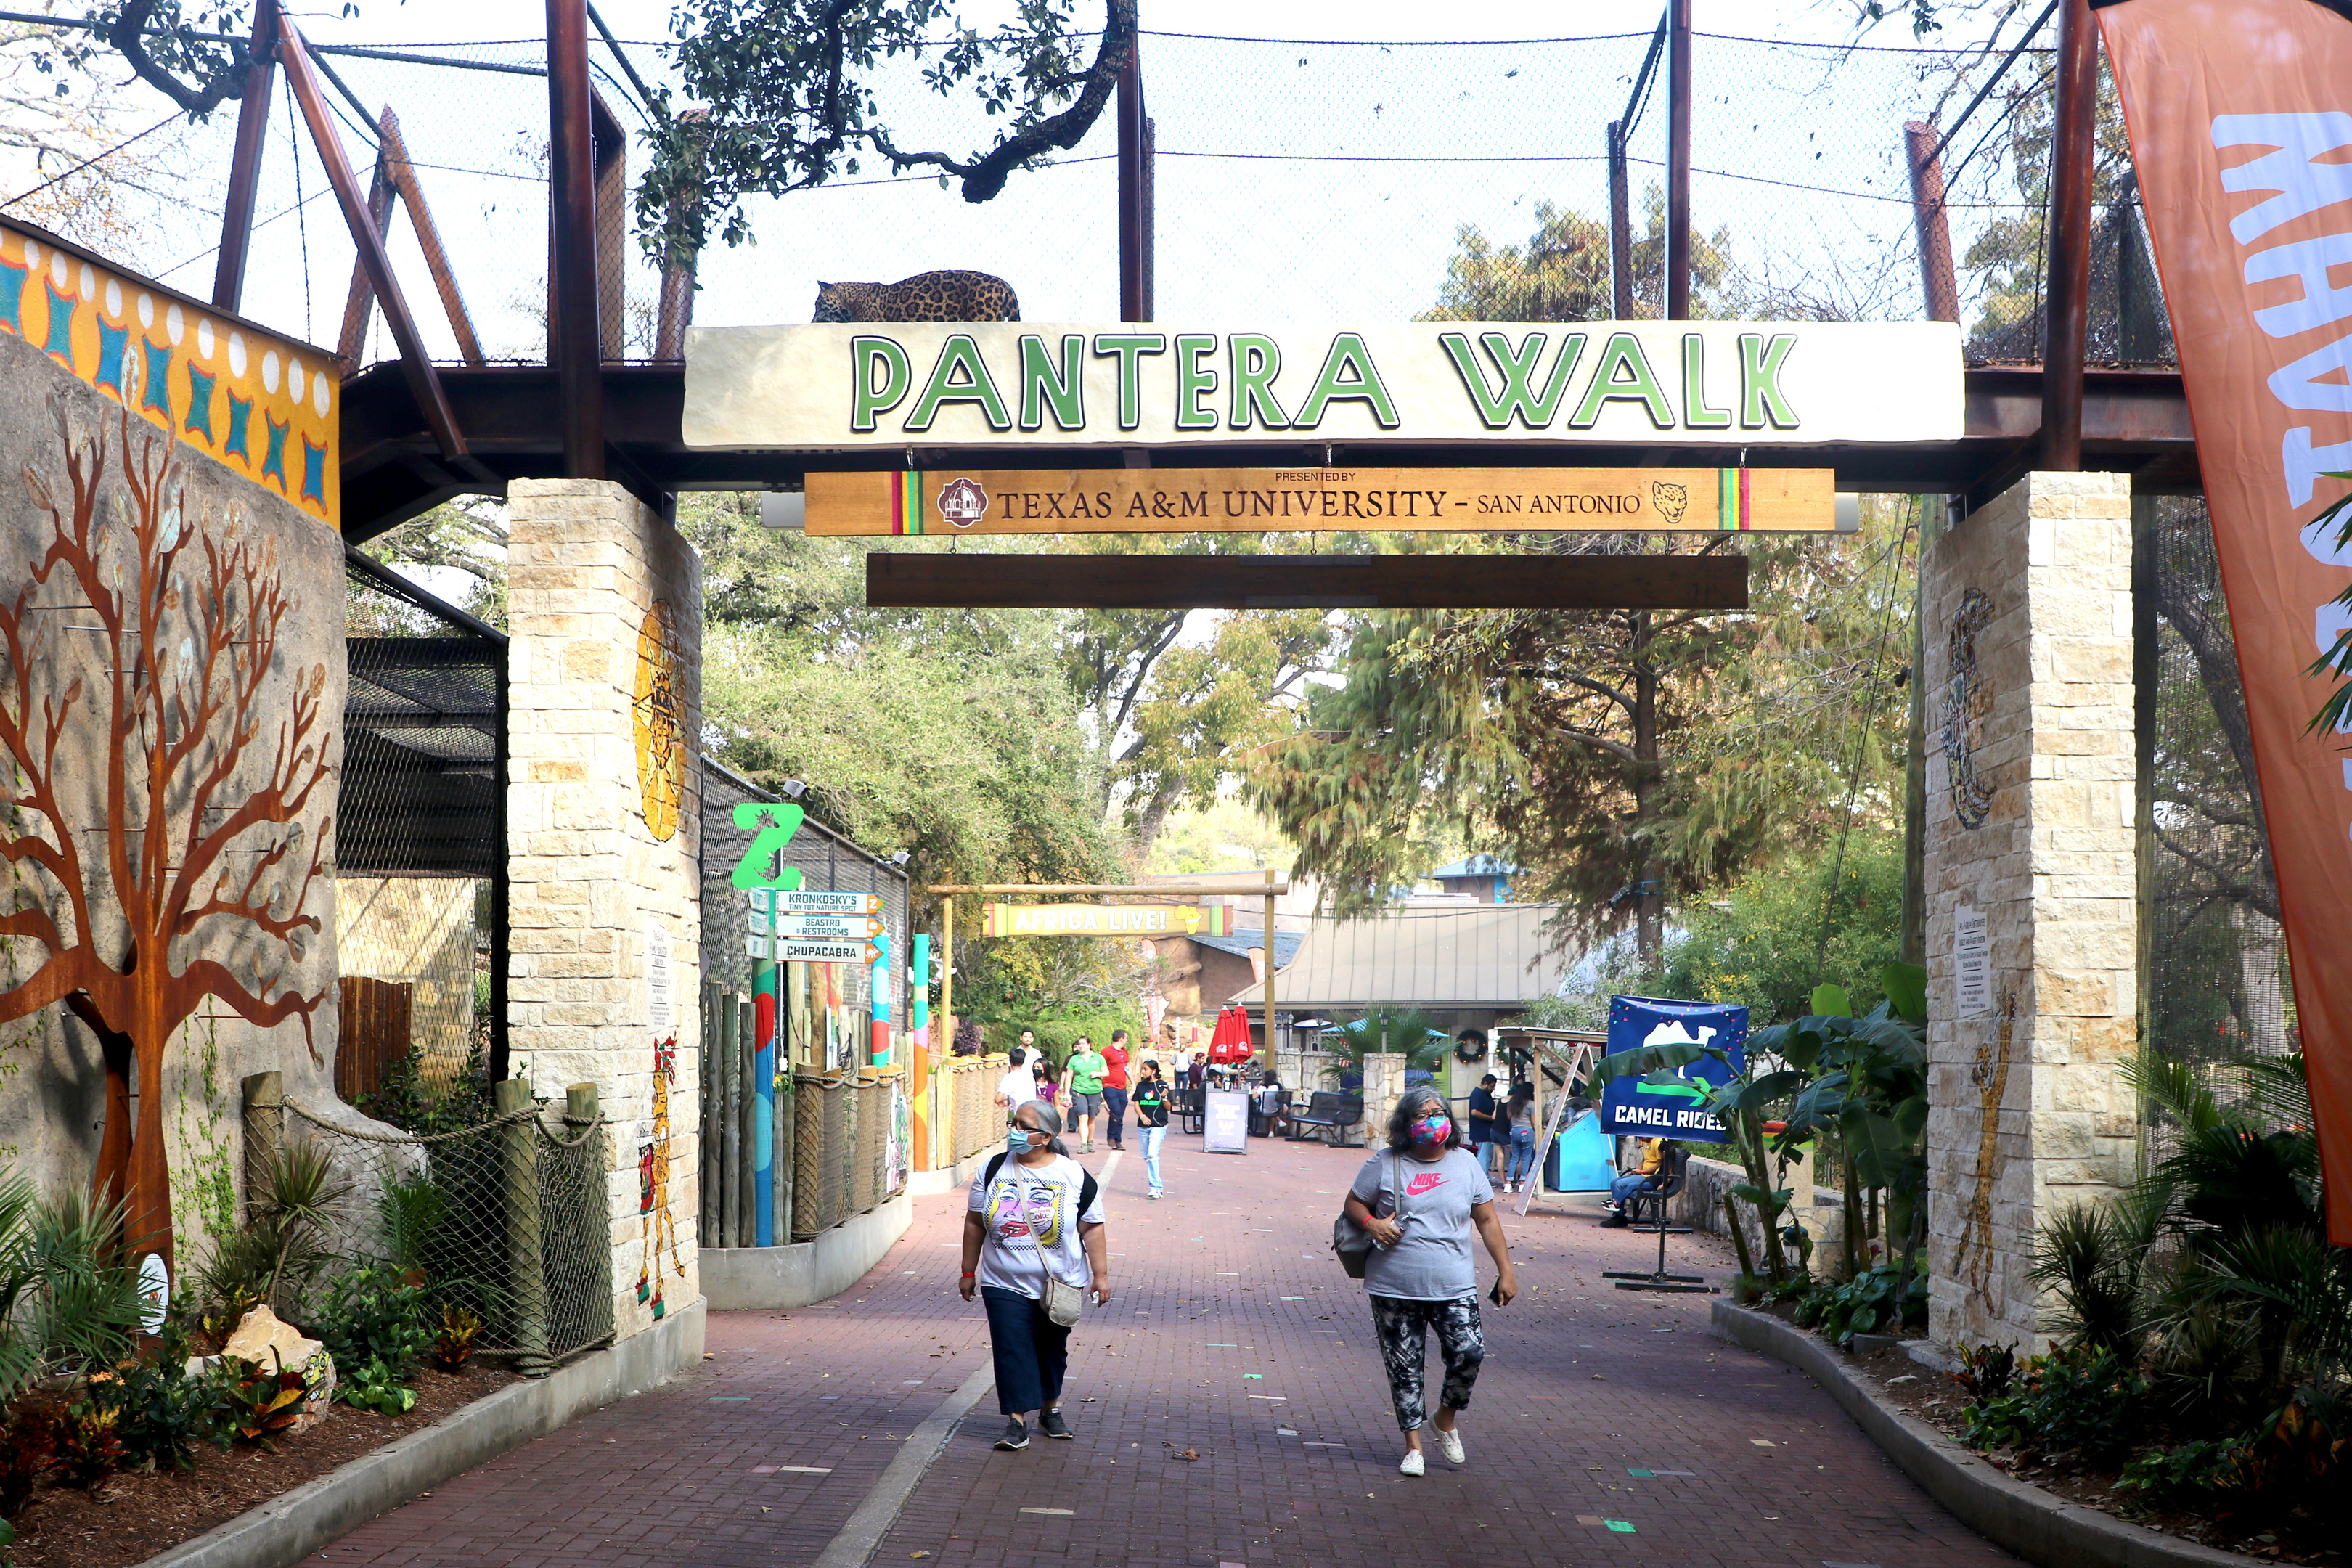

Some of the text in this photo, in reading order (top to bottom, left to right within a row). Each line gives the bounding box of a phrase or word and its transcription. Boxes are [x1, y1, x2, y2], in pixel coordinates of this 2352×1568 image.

[851, 332, 1800, 431] PANTERA WALK
[1275, 473, 1356, 481] PRESENTED BY
[997, 491, 1112, 520] TEXAS
[1126, 491, 1209, 519] A&M
[1222, 490, 1447, 518] UNIVERSITY
[1477, 495, 1523, 513] SAN
[1529, 495, 1641, 513] ANTONIO
[788, 894, 857, 905] KRONKOSKY'S
[1016, 910, 1167, 931] AFRICA LIVE!
[787, 946, 857, 957] CHUPACABRA
[1615, 1106, 1673, 1127] CAMEL
[1413, 1172, 1442, 1185] NIKE
